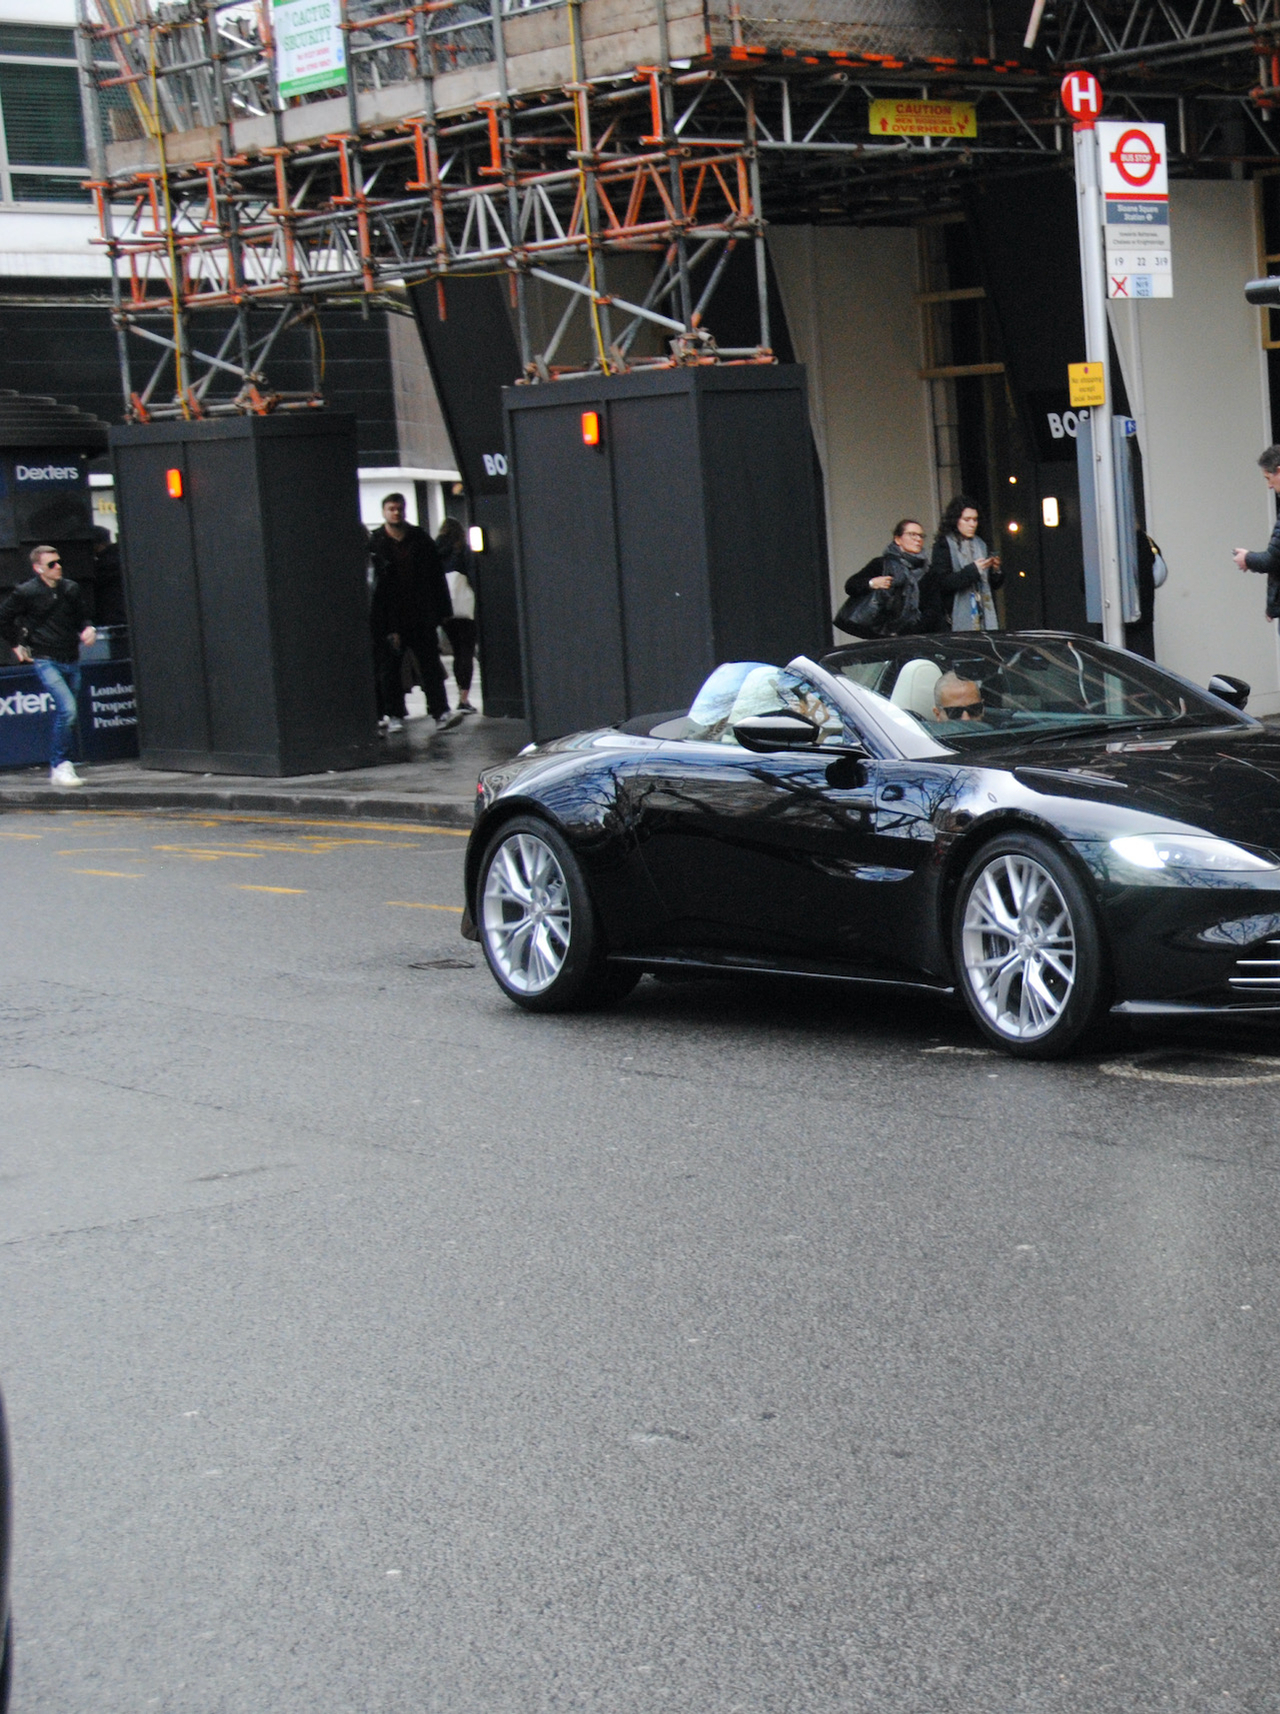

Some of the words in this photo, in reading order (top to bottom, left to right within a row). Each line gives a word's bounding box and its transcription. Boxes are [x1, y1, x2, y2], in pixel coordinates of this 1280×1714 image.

[292, 3, 331, 27] CACTUS
[284, 25, 332, 51] SECURITY
[1071, 76, 1097, 112] H
[895, 103, 952, 115] CAUTION
[892, 124, 956, 134] OVERHEAD
[1121, 153, 1134, 162] BUS
[1135, 153, 1152, 163] STOP
[1117, 204, 1138, 212] Sloane
[1138, 205, 1159, 213] Square
[1124, 213, 1145, 221] Station
[1115, 257, 1124, 266] 19
[1137, 257, 1146, 266] 22
[1155, 257, 1168, 266] 319
[16, 465, 79, 481] Dexters
